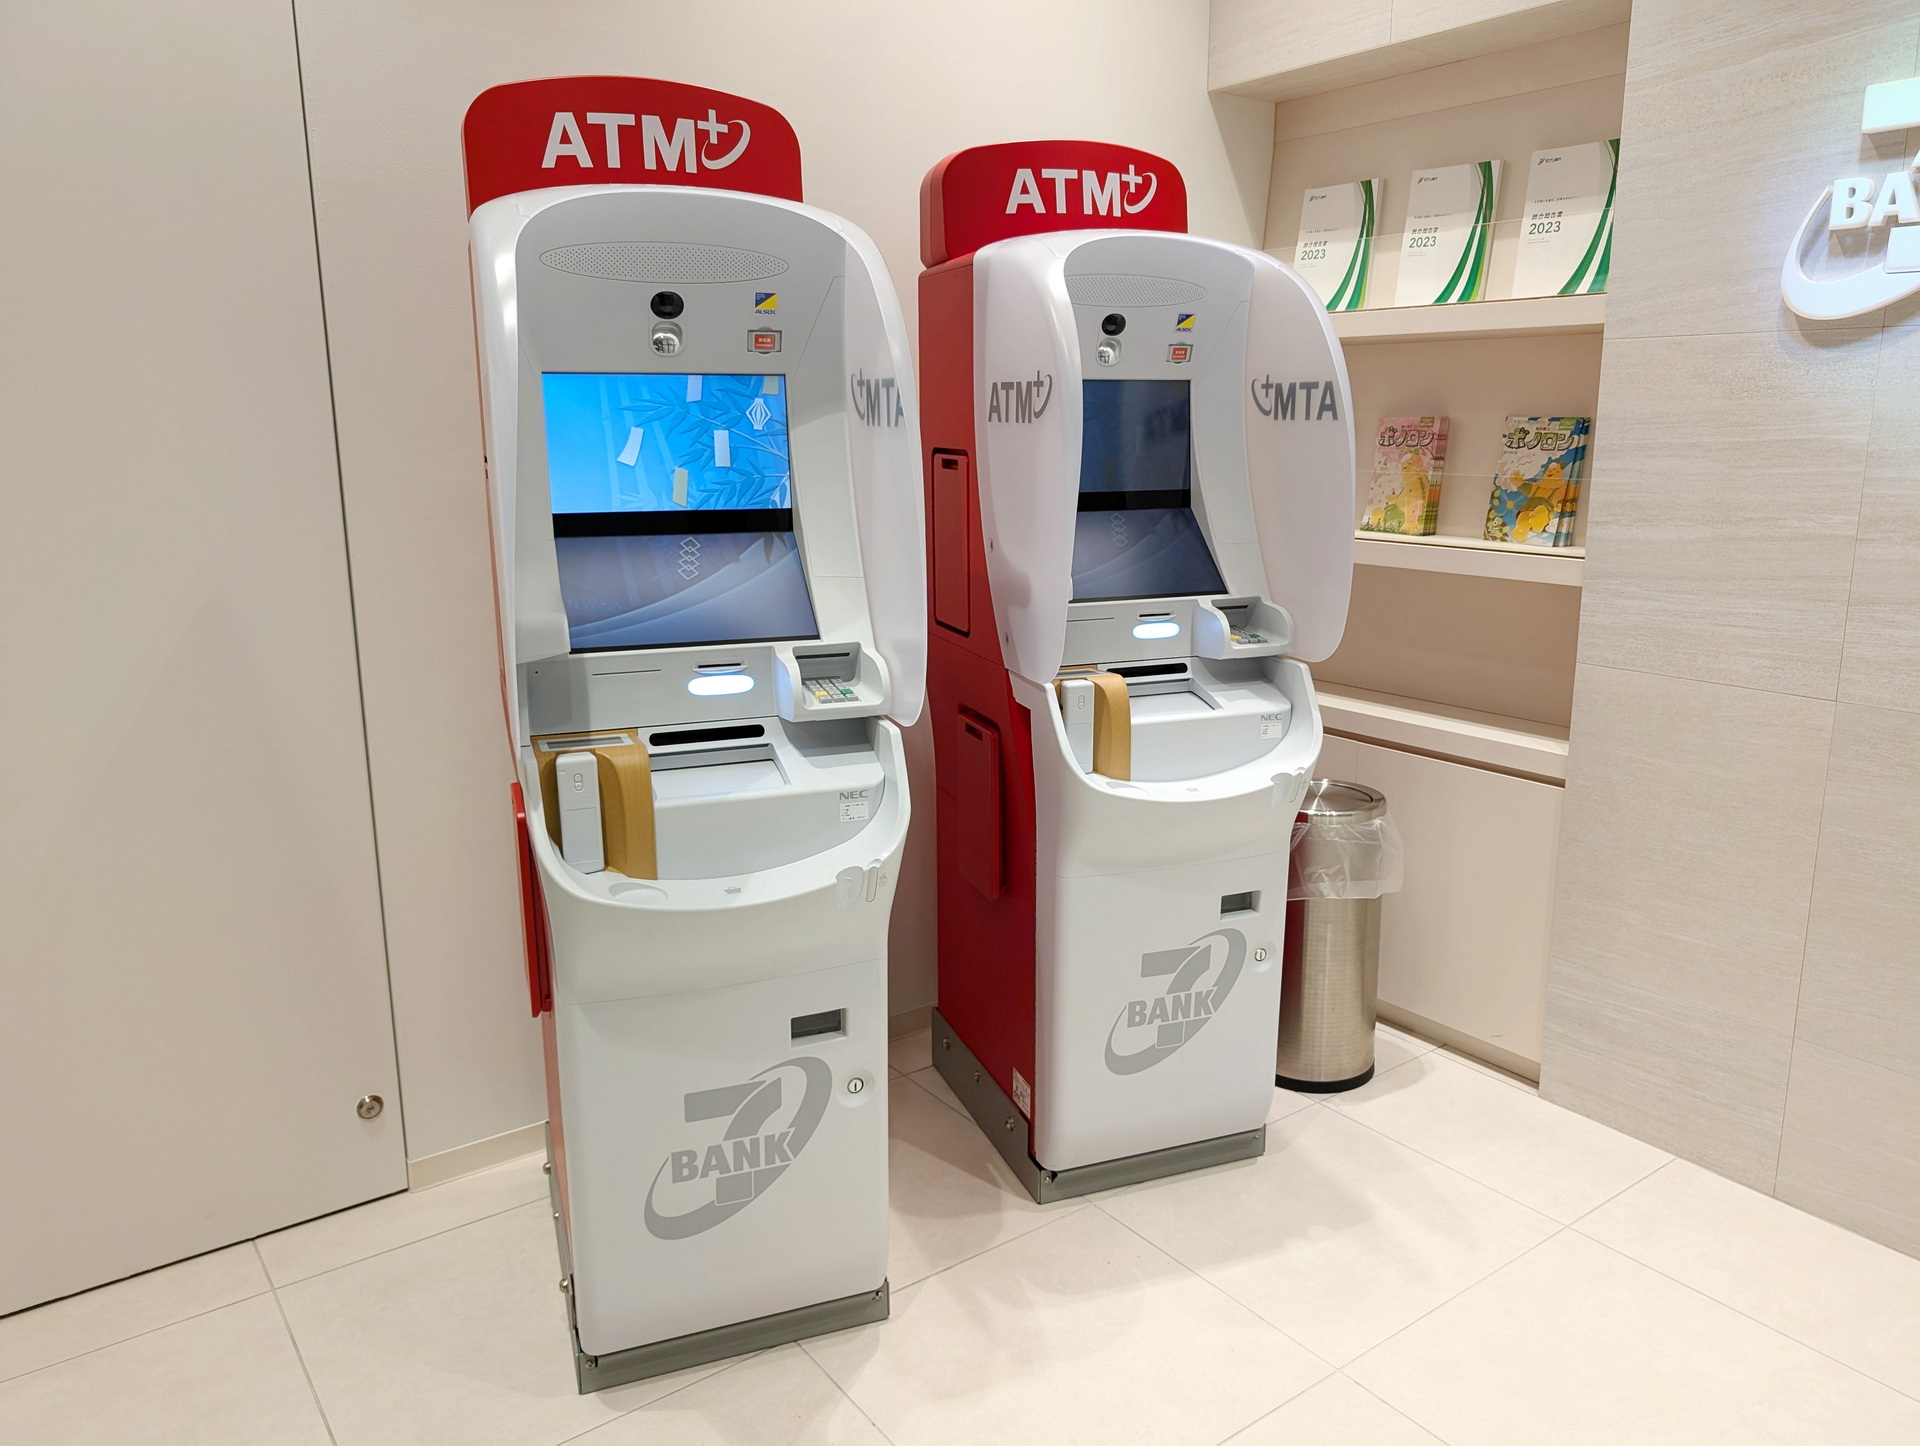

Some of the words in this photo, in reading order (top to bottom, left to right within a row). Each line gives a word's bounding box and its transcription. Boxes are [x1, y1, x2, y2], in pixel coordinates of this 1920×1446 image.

[1529, 221, 1561, 235] 2023
[1409, 236, 1437, 248] 2023
[1301, 249, 1326, 260] 2023
[1261, 713, 1282, 721] NEC
[839, 789, 869, 800] NEC
[1127, 988, 1216, 1028] BANK
[671, 1129, 792, 1184] BANK
